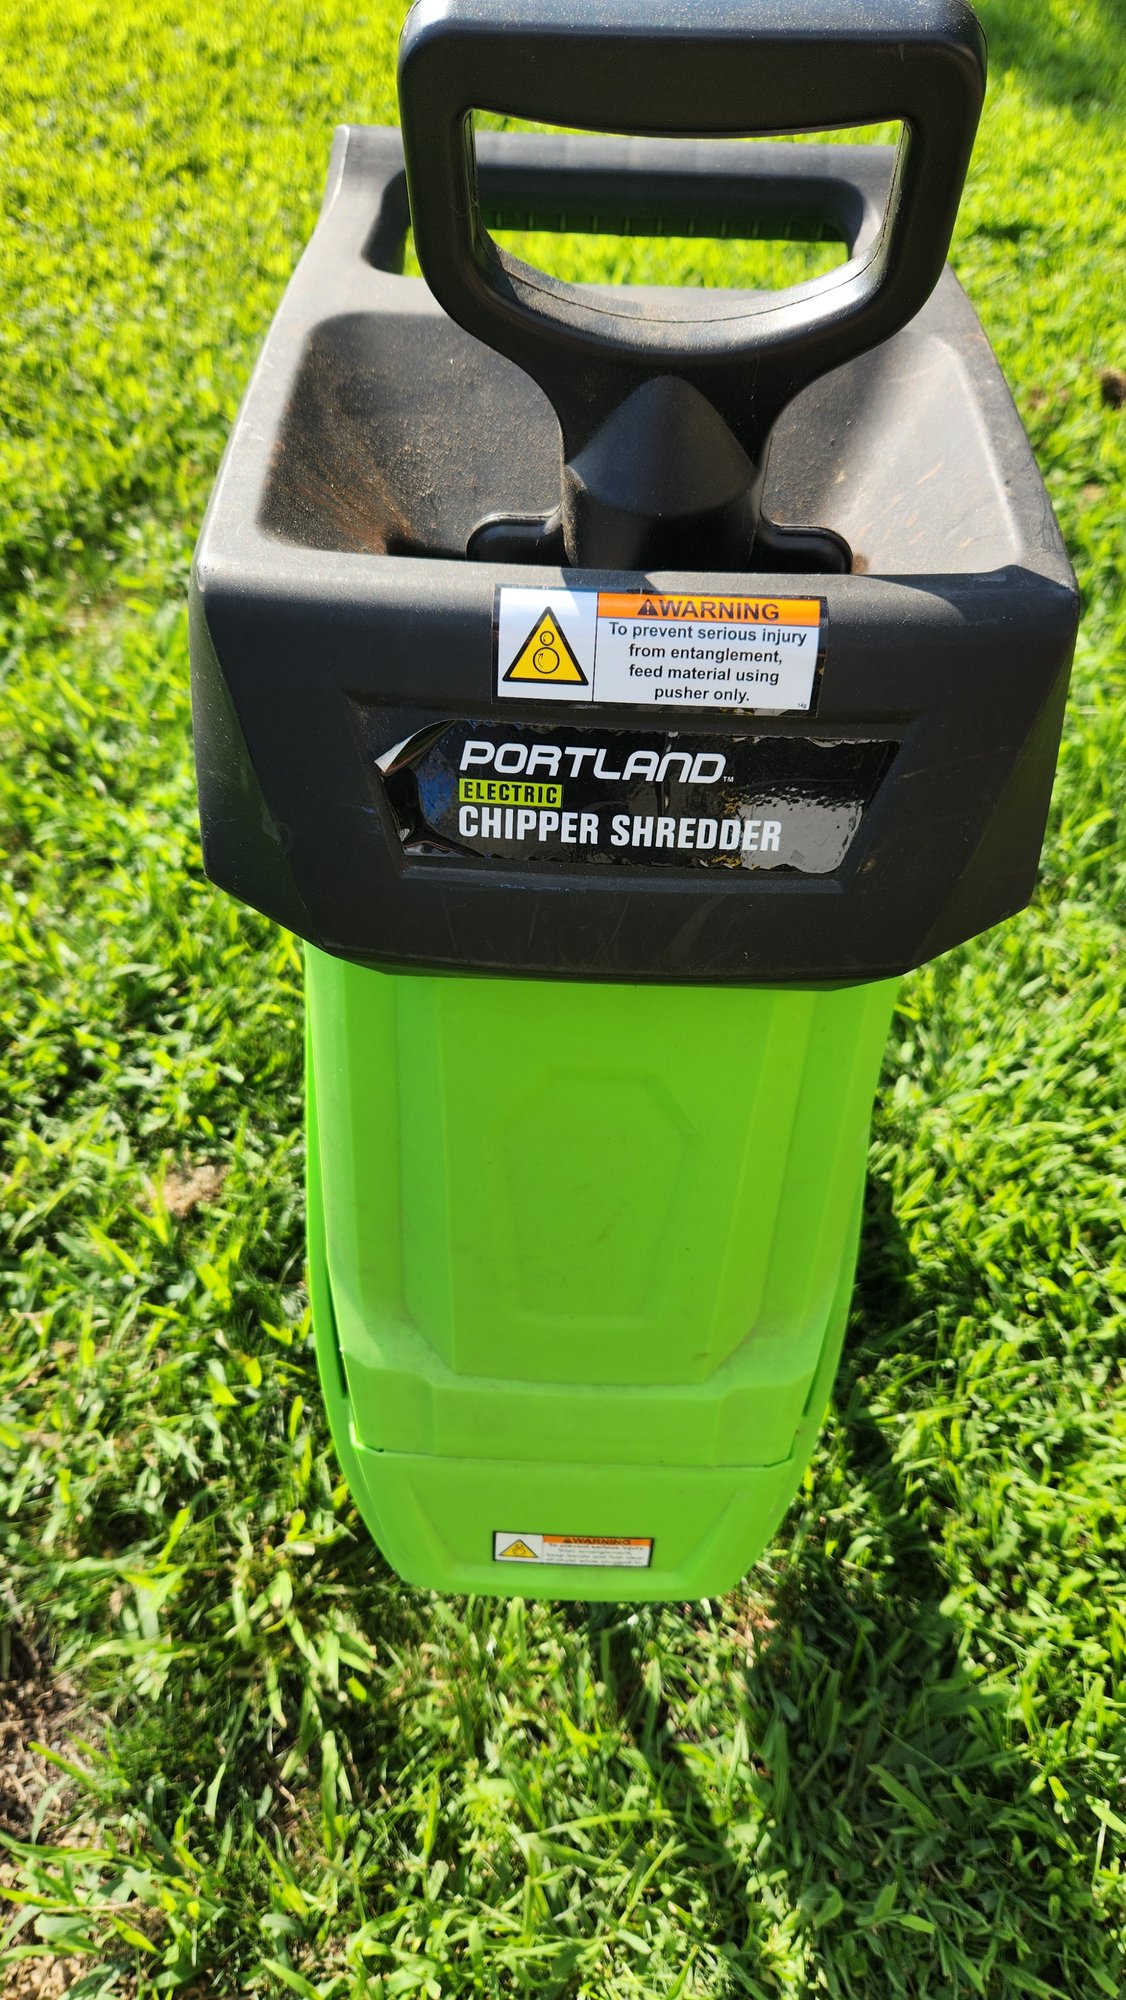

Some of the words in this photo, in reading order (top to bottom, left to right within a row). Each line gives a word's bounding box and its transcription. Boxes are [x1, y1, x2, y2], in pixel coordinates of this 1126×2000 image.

[659, 599, 780, 621] WARNING
[608, 621, 627, 636] To
[632, 624, 693, 640] prevent
[698, 627, 757, 642] serious
[762, 628, 808, 647] injury
[628, 643, 666, 658] from
[670, 646, 783, 666] entanglement,
[628, 664, 663, 679] feed
[667, 666, 731, 682] material
[736, 669, 780, 686] using
[654, 685, 709, 701] pusher
[713, 687, 750, 702] only.
[459, 740, 727, 785] PORTLAND
[463, 781, 558, 804] ELECTRIC
[458, 804, 600, 845] CHIPPER
[610, 814, 782, 852] SHREDDER
[571, 1537, 632, 1546] WARNING
